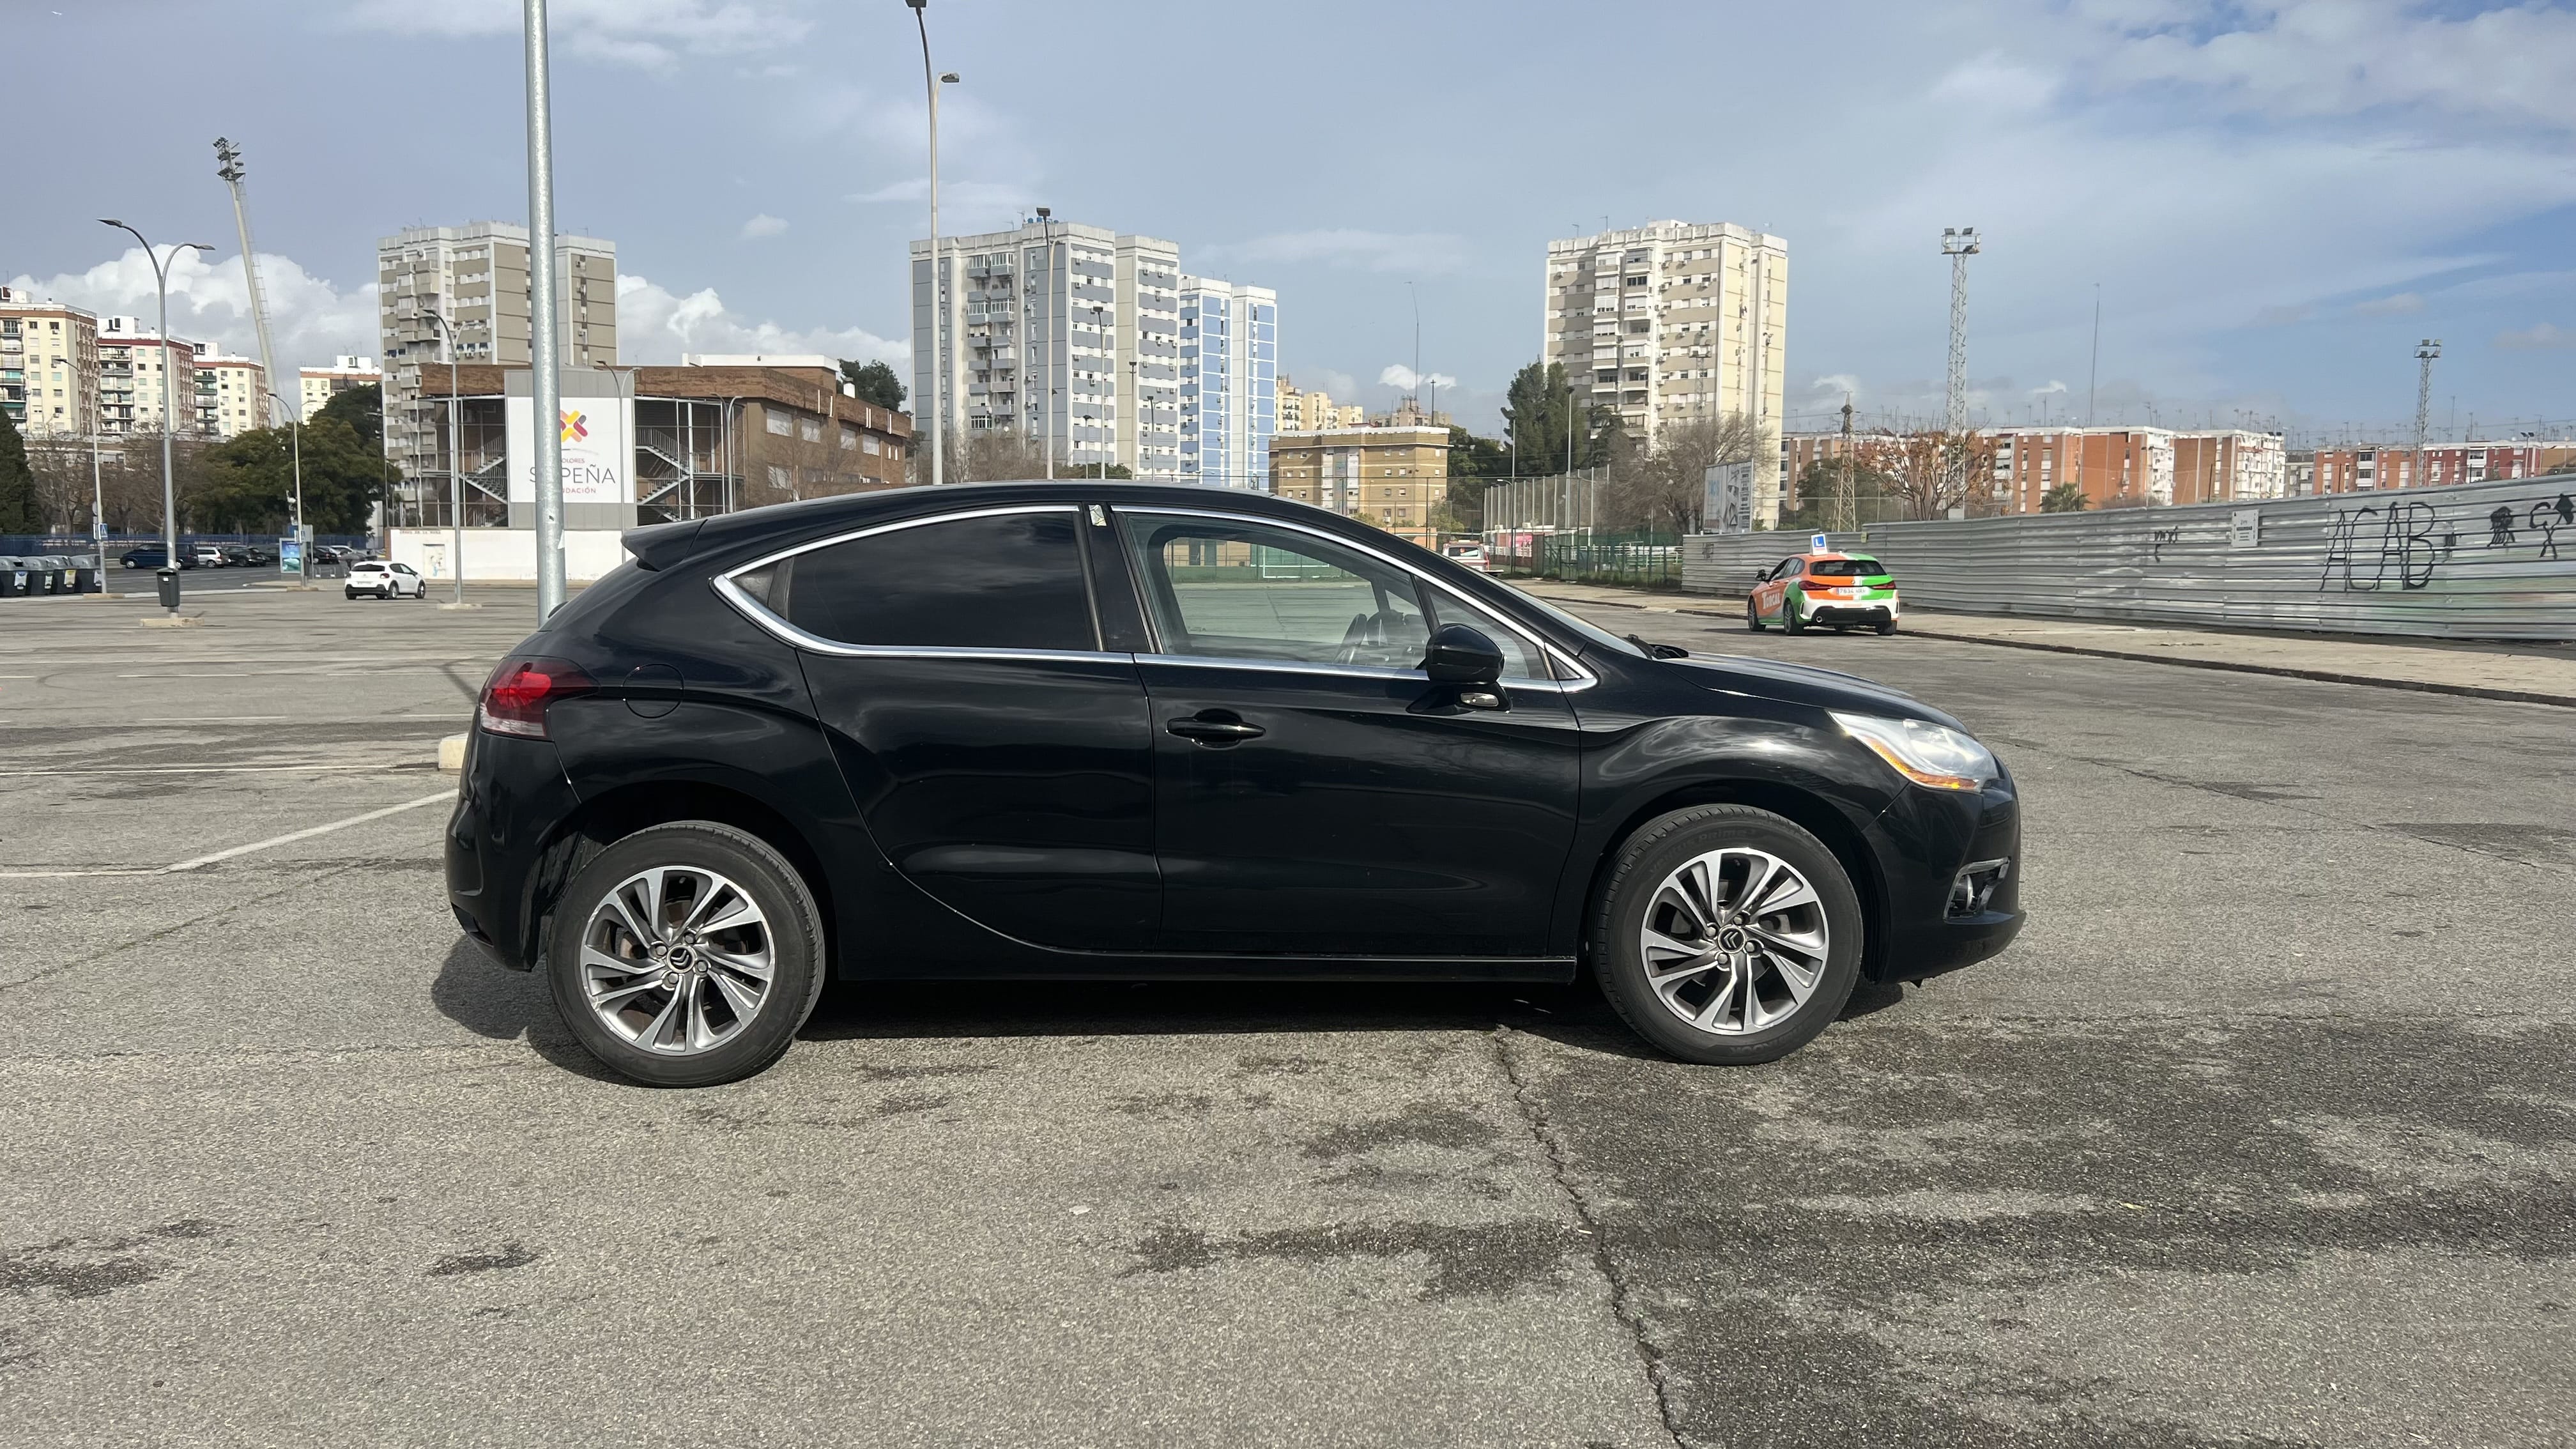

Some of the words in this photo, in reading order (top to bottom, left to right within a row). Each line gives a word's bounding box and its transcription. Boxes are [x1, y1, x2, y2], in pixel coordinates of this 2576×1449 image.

[530, 464, 615, 484] SPEÑA
[1815, 538, 1822, 546] L
[2320, 502, 2435, 592] ACAB
